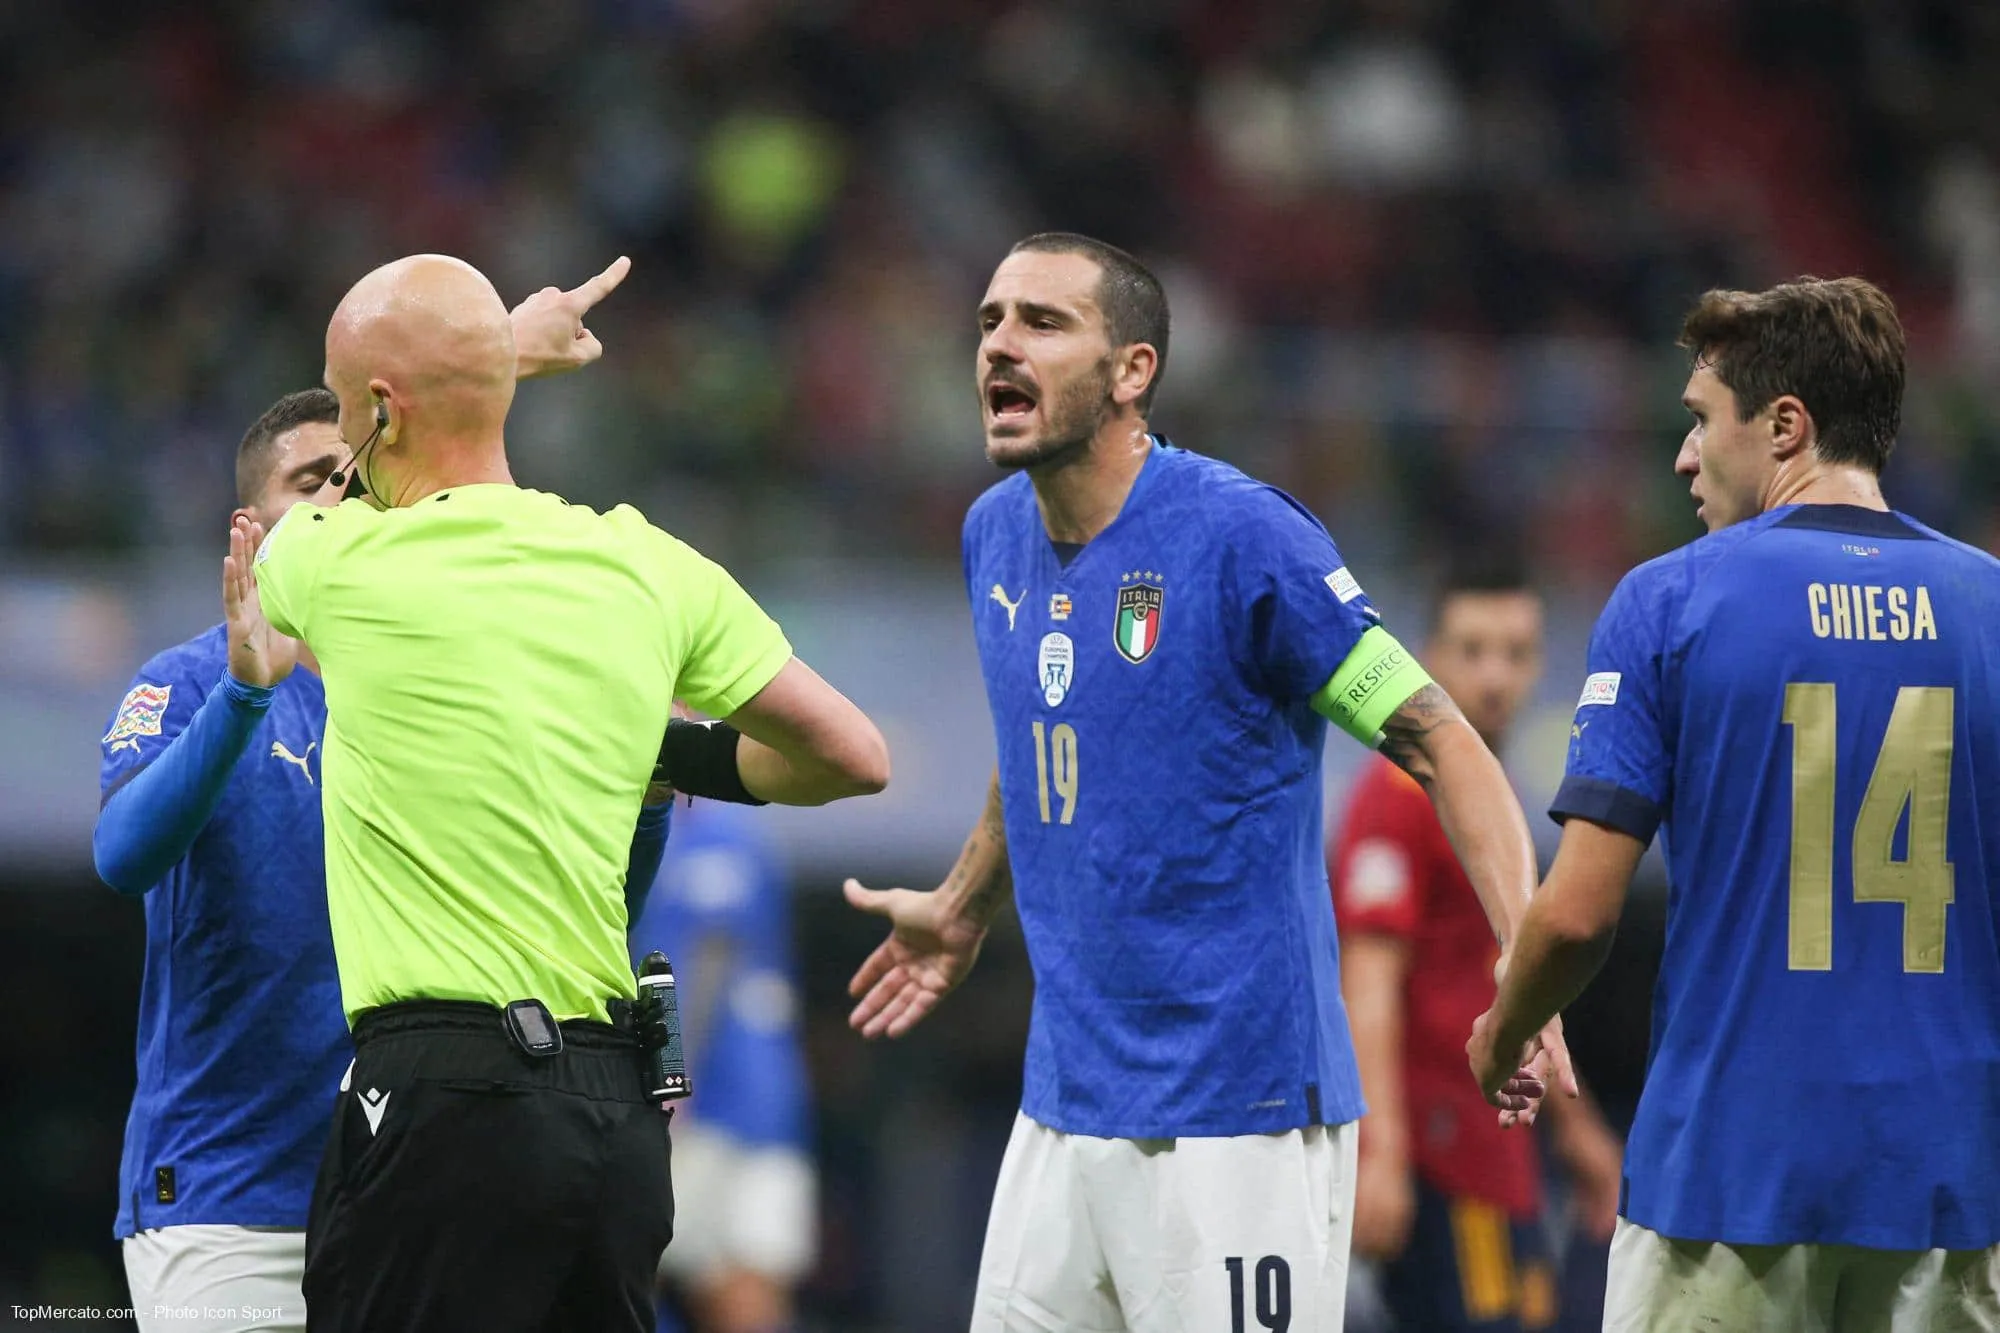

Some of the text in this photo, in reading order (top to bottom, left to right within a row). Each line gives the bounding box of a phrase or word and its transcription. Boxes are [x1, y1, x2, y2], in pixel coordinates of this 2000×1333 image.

[1841, 544, 1880, 554] ITALIA
[1122, 590, 1160, 603] ITALIA
[1807, 582, 1937, 641] CHIESA
[1032, 721, 1078, 825] 19
[1781, 682, 1955, 973] 14
[1225, 1254, 1292, 1333] 19
